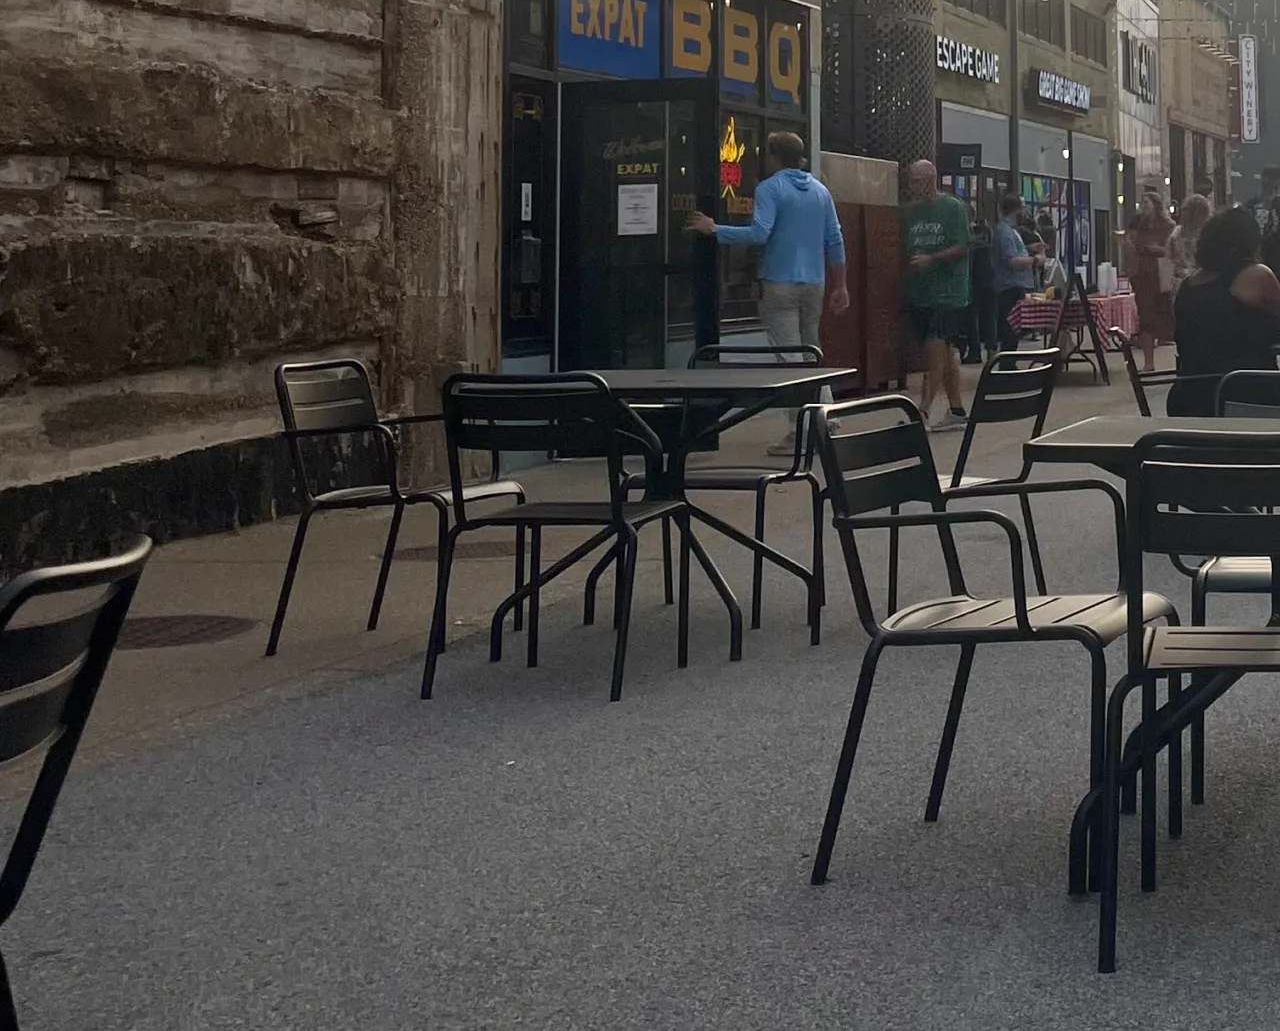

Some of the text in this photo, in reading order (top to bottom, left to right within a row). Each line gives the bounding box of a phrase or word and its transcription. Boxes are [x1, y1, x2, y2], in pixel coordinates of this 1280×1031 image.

[936, 35, 999, 83] ESCAPE GAME
[1244, 39, 1254, 136] CITY WINERY
[617, 163, 659, 175] EXPAT
